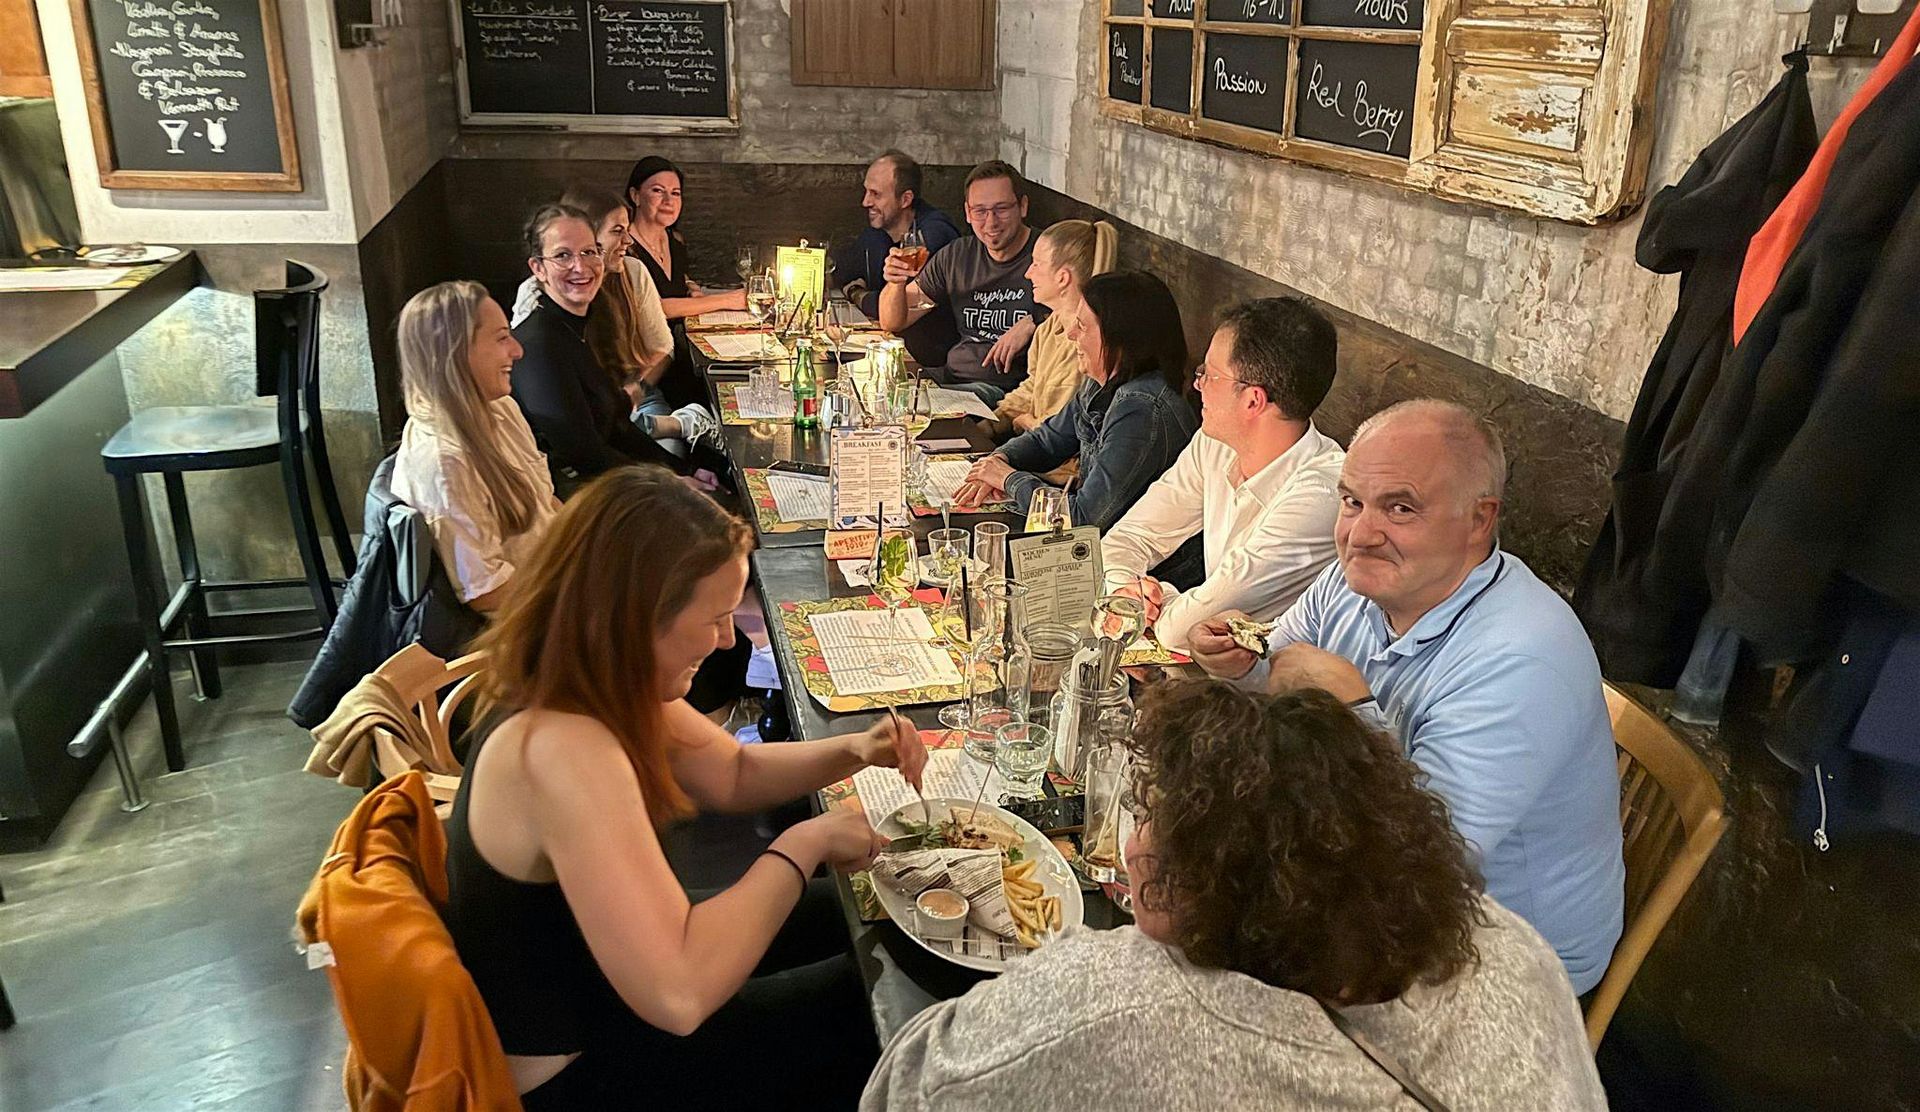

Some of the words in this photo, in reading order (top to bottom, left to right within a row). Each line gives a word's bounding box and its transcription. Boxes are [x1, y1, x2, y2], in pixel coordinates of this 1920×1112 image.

[1214, 57, 1267, 94] Passion
[1307, 60, 1345, 117] Red
[1353, 80, 1404, 151] Berry
[833, 532, 876, 547] APERITIVO
